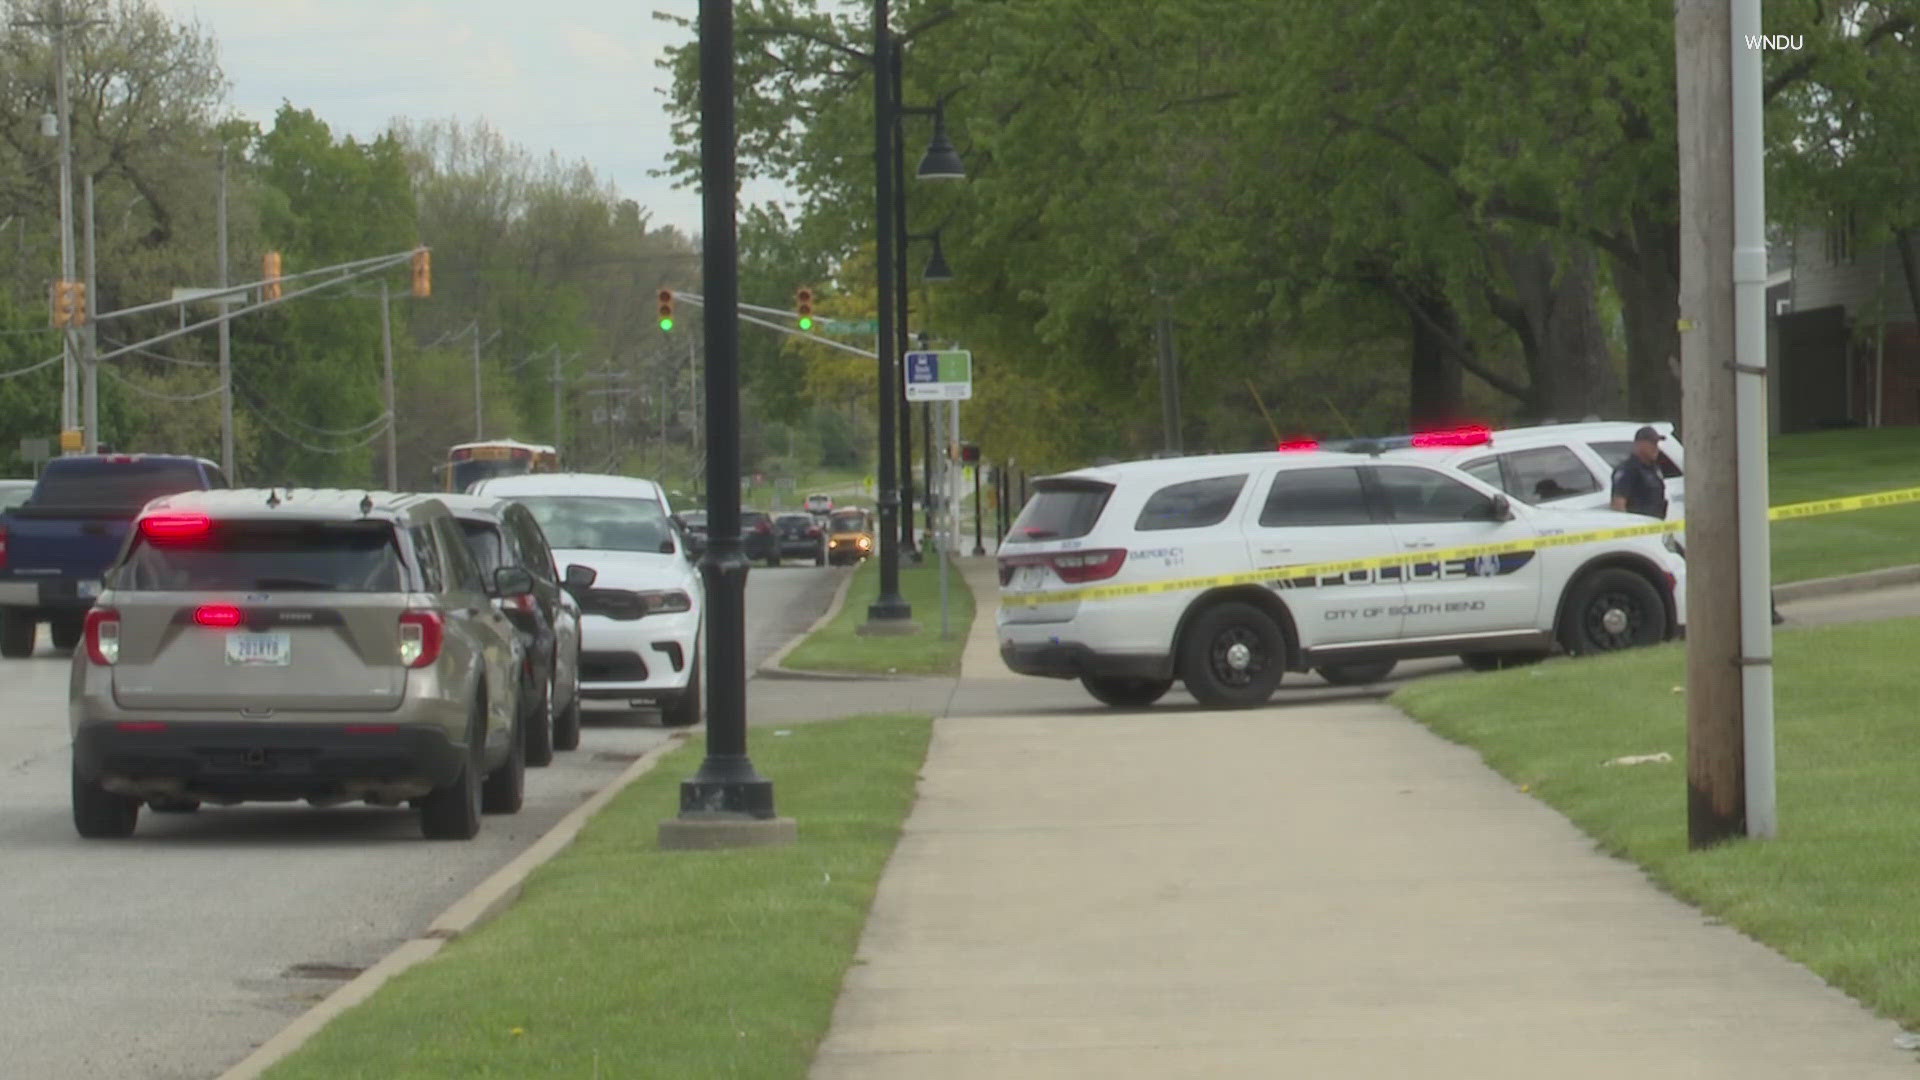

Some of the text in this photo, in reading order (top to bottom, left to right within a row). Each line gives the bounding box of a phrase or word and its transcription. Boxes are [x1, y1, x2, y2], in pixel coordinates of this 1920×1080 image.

[1315, 558, 1467, 588] POLICE
[1324, 601, 1486, 621] CITY OF SOUTH BEND
